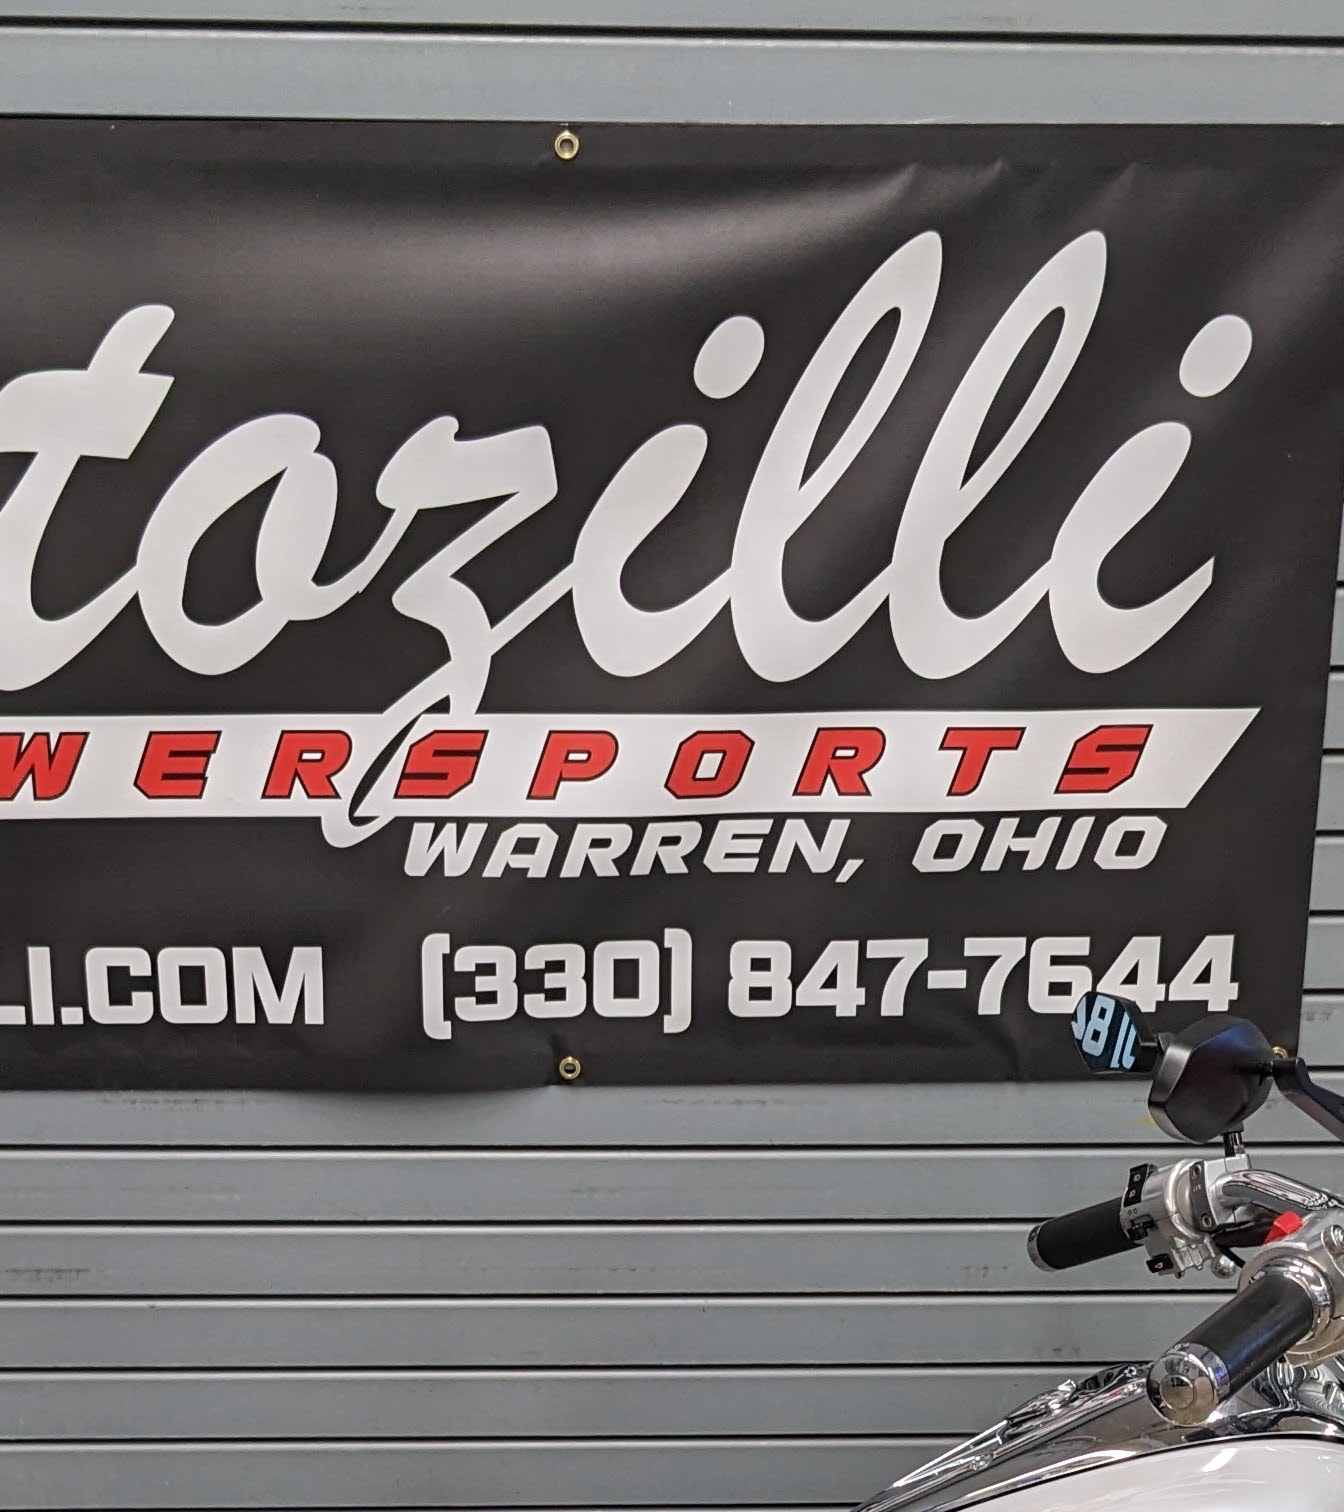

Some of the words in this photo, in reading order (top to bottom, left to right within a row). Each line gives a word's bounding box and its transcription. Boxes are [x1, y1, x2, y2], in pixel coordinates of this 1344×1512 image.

[403, 818, 866, 883] WARREN,
[911, 815, 1168, 873] OHIO
[421, 928, 693, 1041] (330)
[727, 934, 1240, 1019] 847-7644
